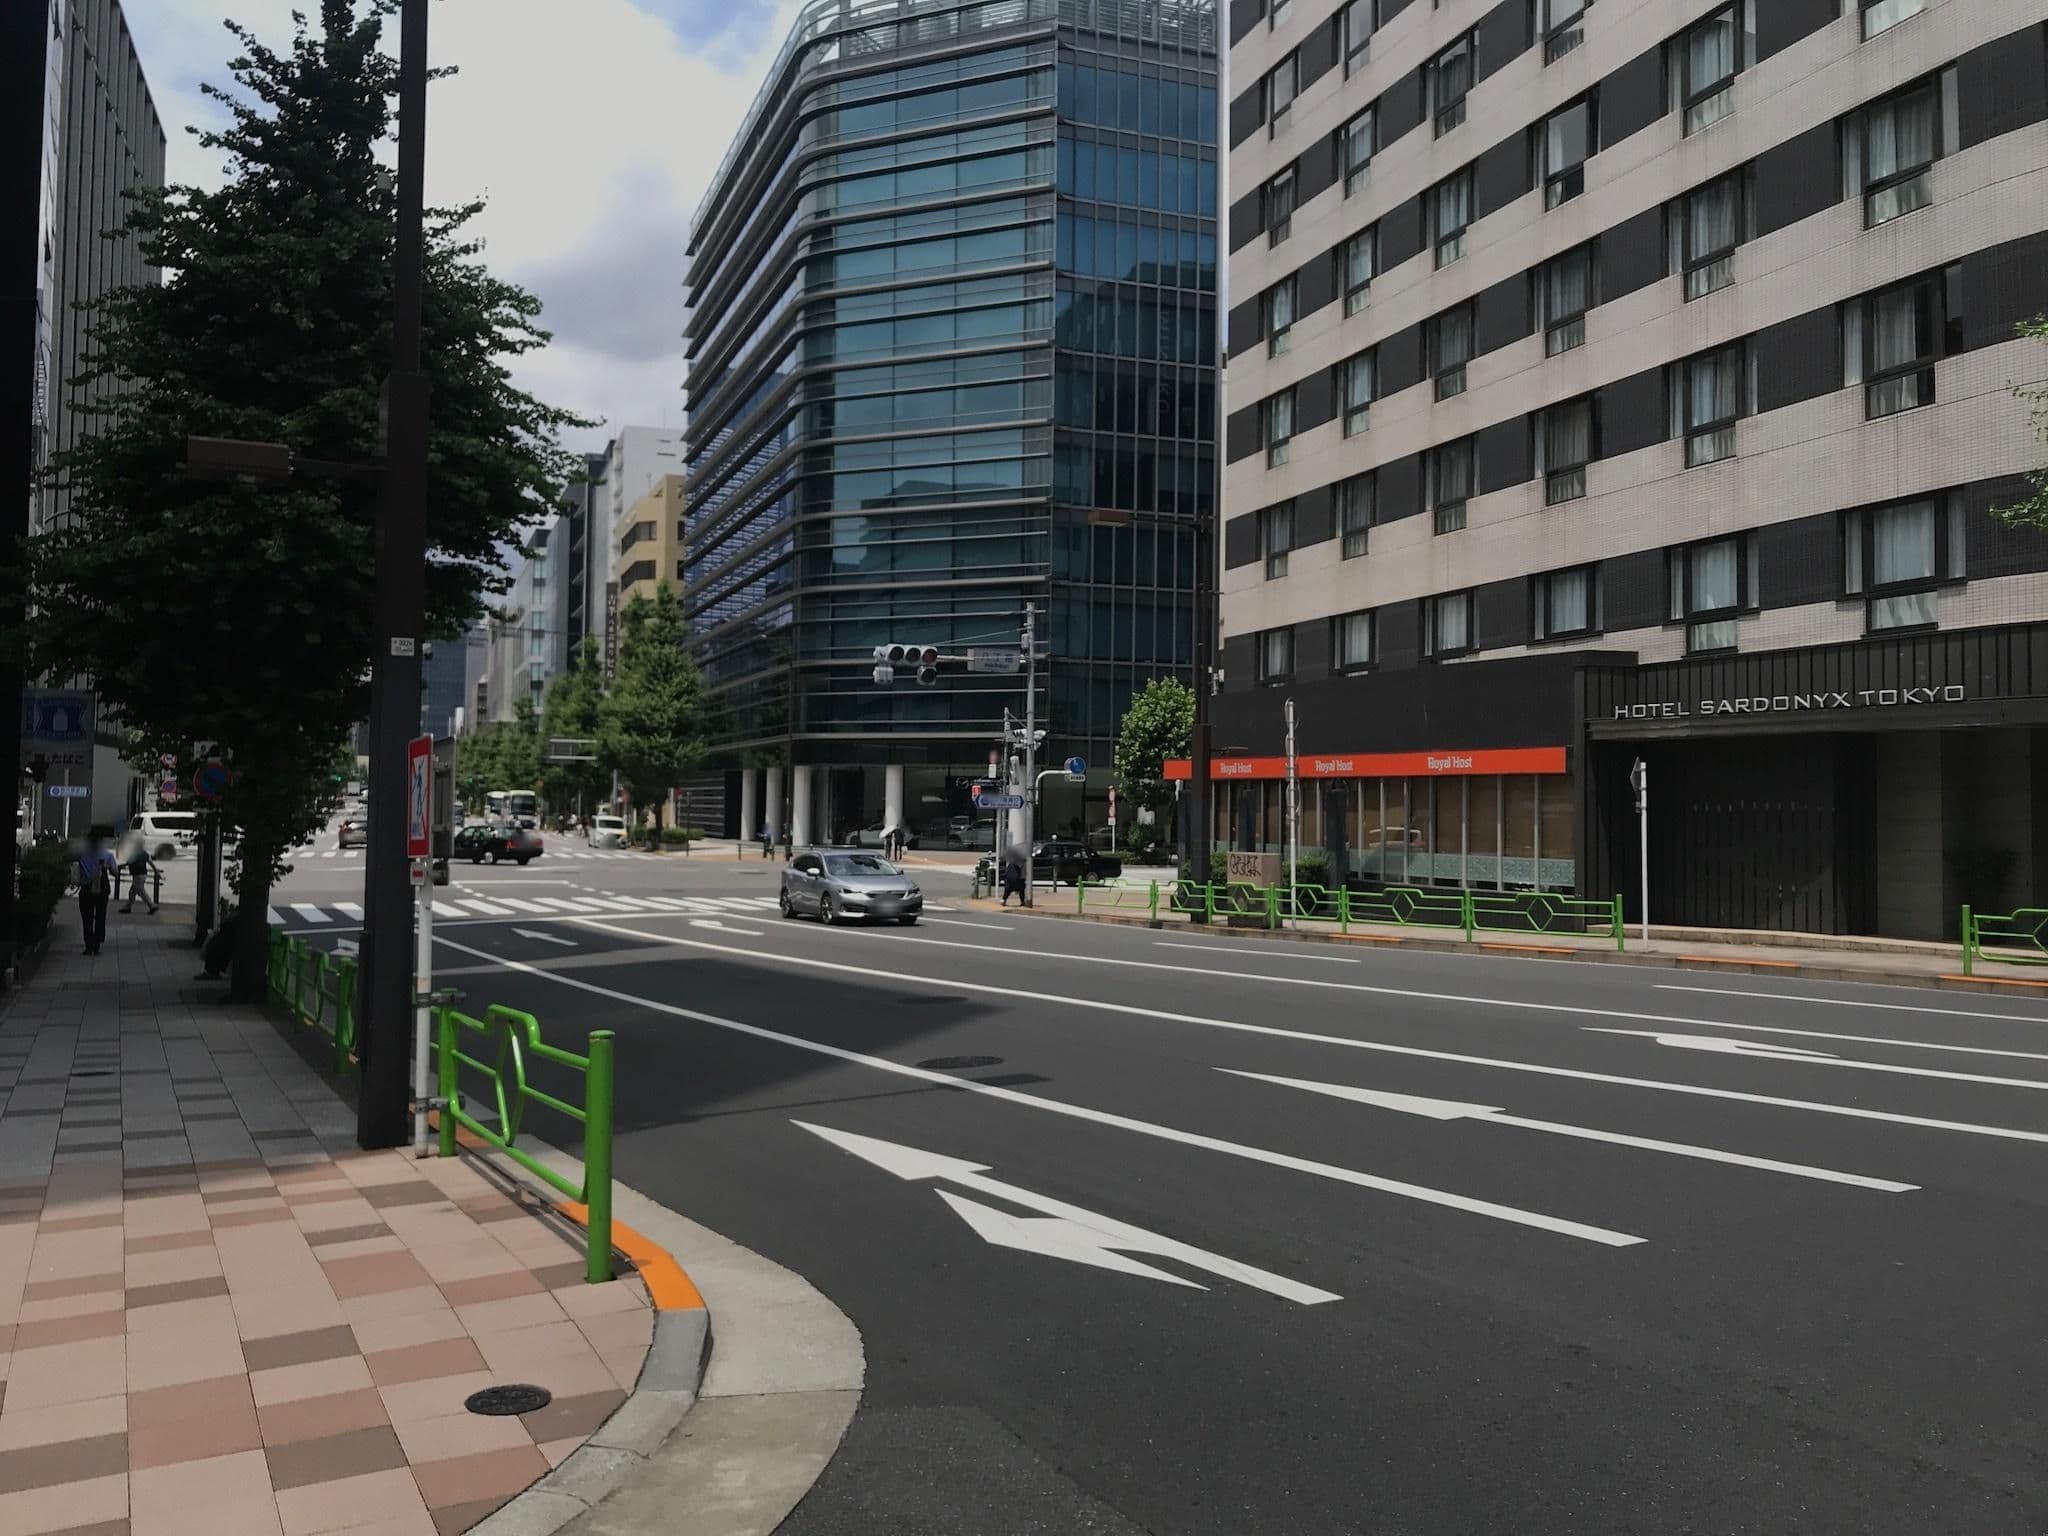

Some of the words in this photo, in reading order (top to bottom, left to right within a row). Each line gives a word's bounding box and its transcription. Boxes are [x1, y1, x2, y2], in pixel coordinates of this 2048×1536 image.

[1615, 702, 1690, 719] HOTEL
[1700, 692, 1851, 715] SARDONYX
[1858, 685, 1965, 706] TOKYO
[1220, 762, 1237, 774] Royal
[1238, 762, 1252, 773] Host
[1315, 760, 1335, 773] Royal
[1336, 760, 1353, 771] Host
[1427, 757, 1451, 770] Royal
[1452, 756, 1473, 768] Host
